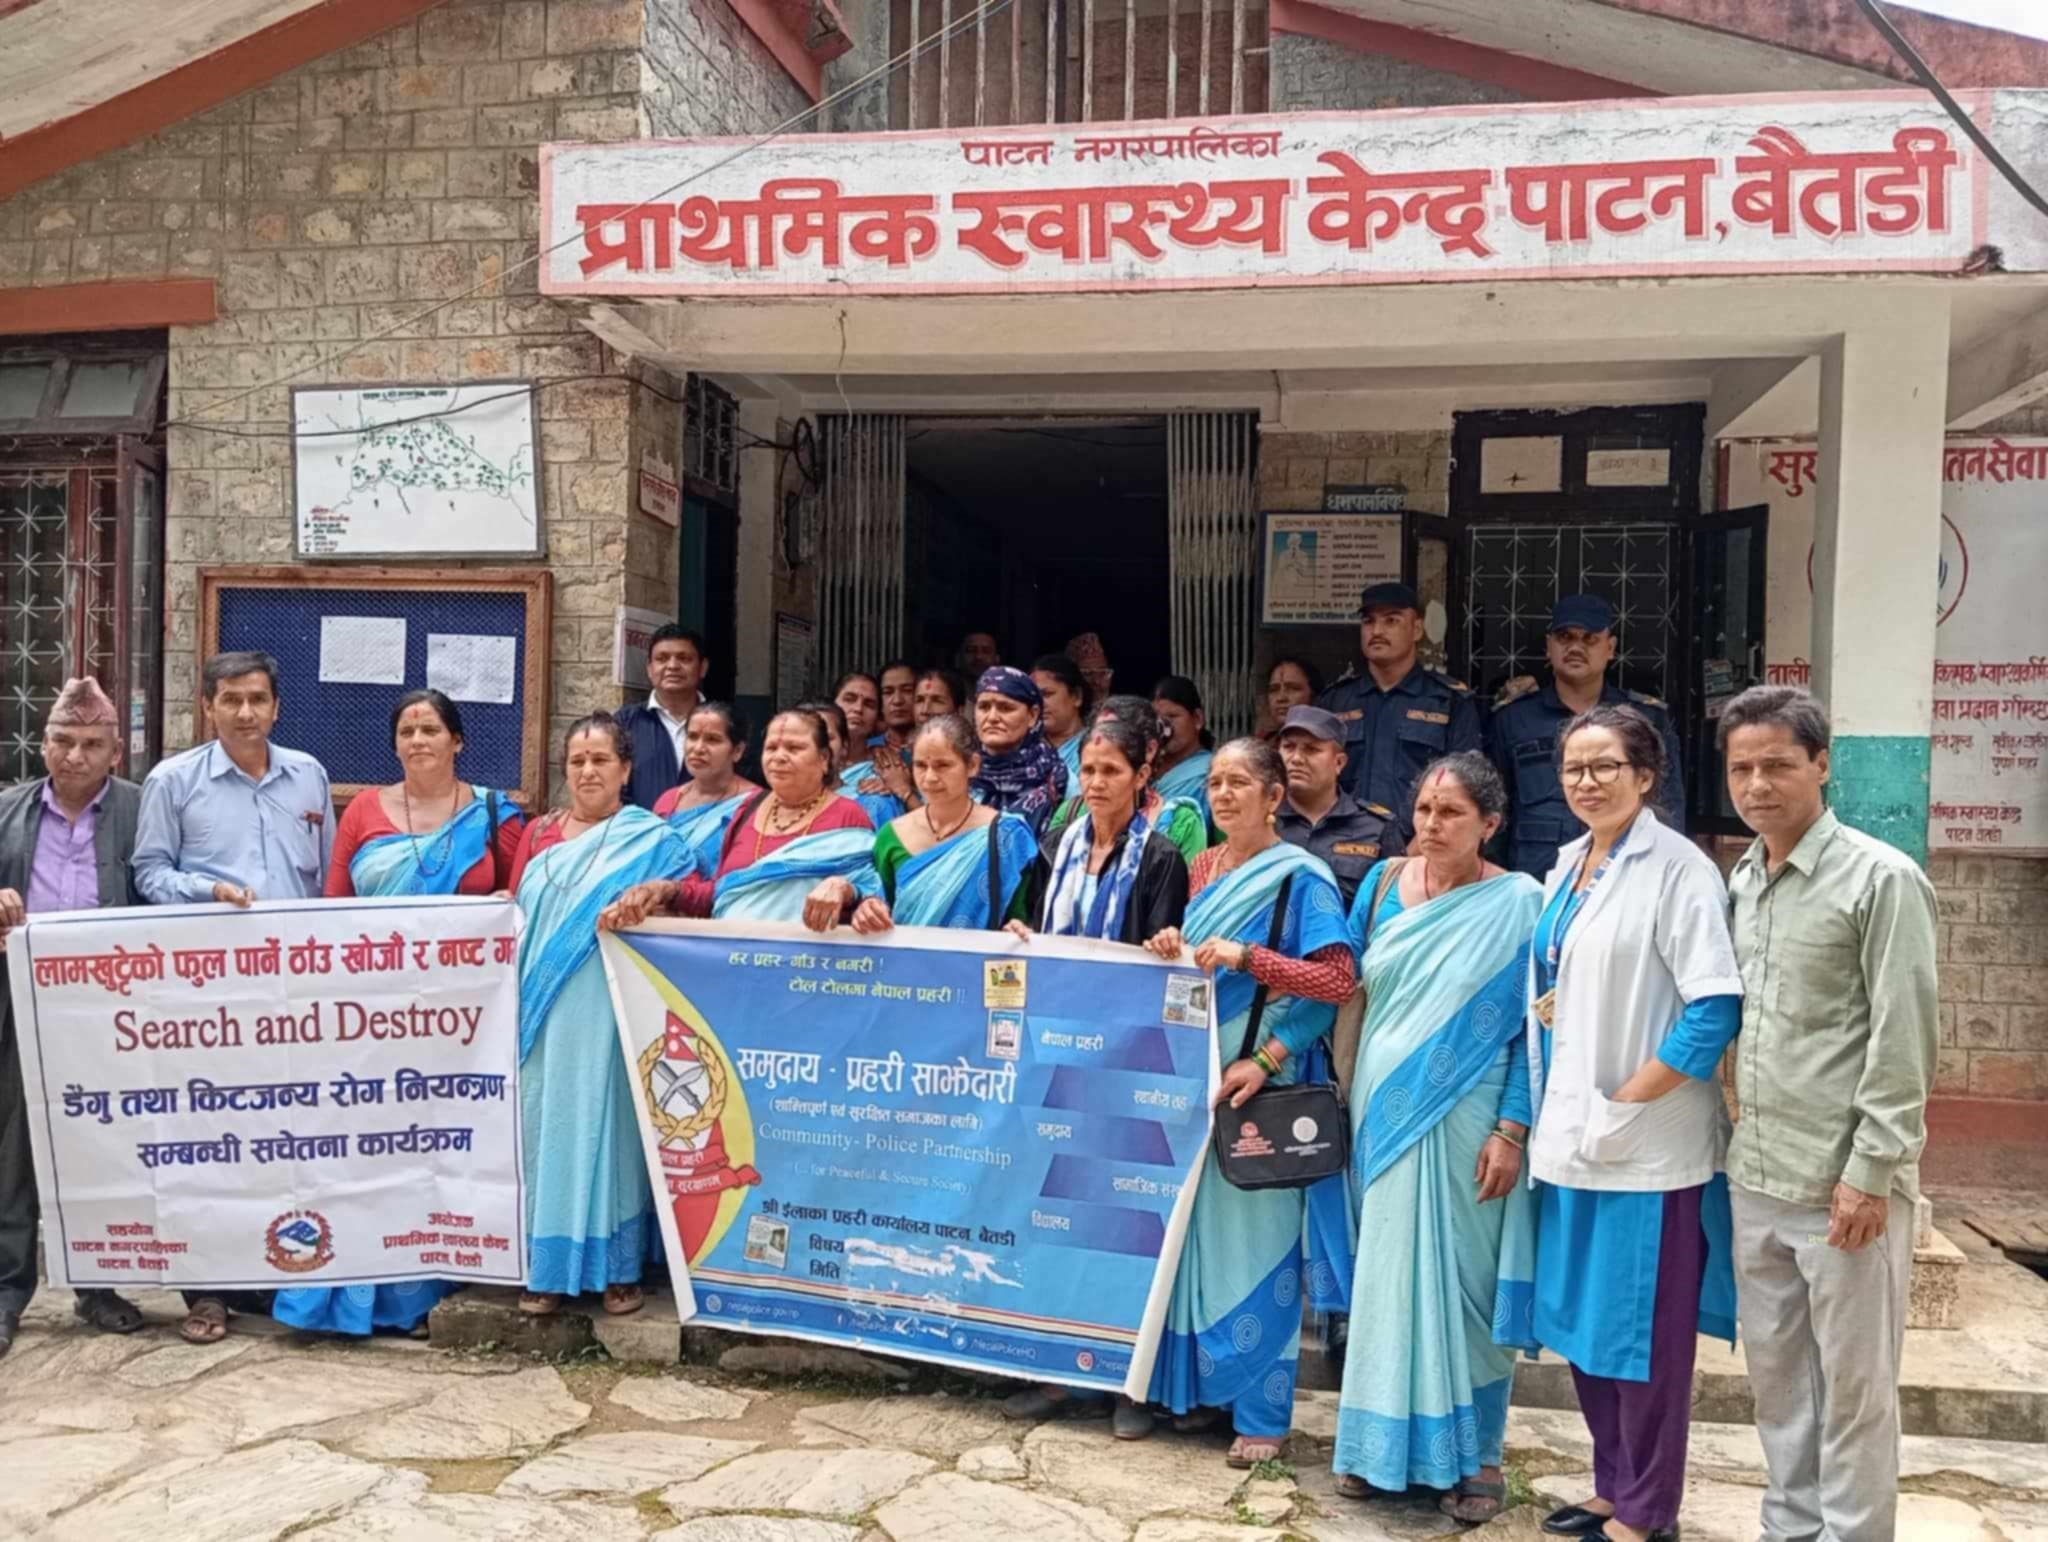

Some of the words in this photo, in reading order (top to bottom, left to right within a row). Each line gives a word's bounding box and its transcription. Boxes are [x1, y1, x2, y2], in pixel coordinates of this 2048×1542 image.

[961, 140, 1053, 167] पाटन
[1074, 126, 1282, 164] नगरपालिका
[576, 179, 937, 277] प्राथमिक
[953, 179, 1292, 270] स्वास्थ्य
[1307, 150, 1497, 258] केन्द्र
[1731, 126, 1958, 236] बैतडी
[34, 943, 165, 996] लामखुट्टेको
[173, 949, 226, 988] फुल
[412, 940, 430, 971] र
[437, 937, 486, 967] नष्ट
[871, 980, 911, 1000] नेपाल
[917, 984, 952, 1003] प्रहरी
[114, 1006, 243, 1052] Search
[255, 1001, 323, 1045] and
[333, 1001, 483, 1047] Destroy
[736, 1048, 821, 1089] समुदाय
[846, 1050, 905, 1092] प्रहरी
[120, 1087, 178, 1117] तथा
[188, 1078, 320, 1113] किटजन्य
[330, 1072, 385, 1108] रोग
[395, 1068, 506, 1103] नियन्त्रण
[137, 1132, 241, 1168] सम्बन्धी
[250, 1128, 348, 1164] सचेतना
[358, 1123, 473, 1157] कार्यक्रम
[865, 1130, 918, 1154] Police
[923, 1138, 1012, 1171] Partnership
[832, 1207, 866, 1227] प्रहरी
[809, 1233, 845, 1253] विषय
[809, 1258, 841, 1279] मिति
